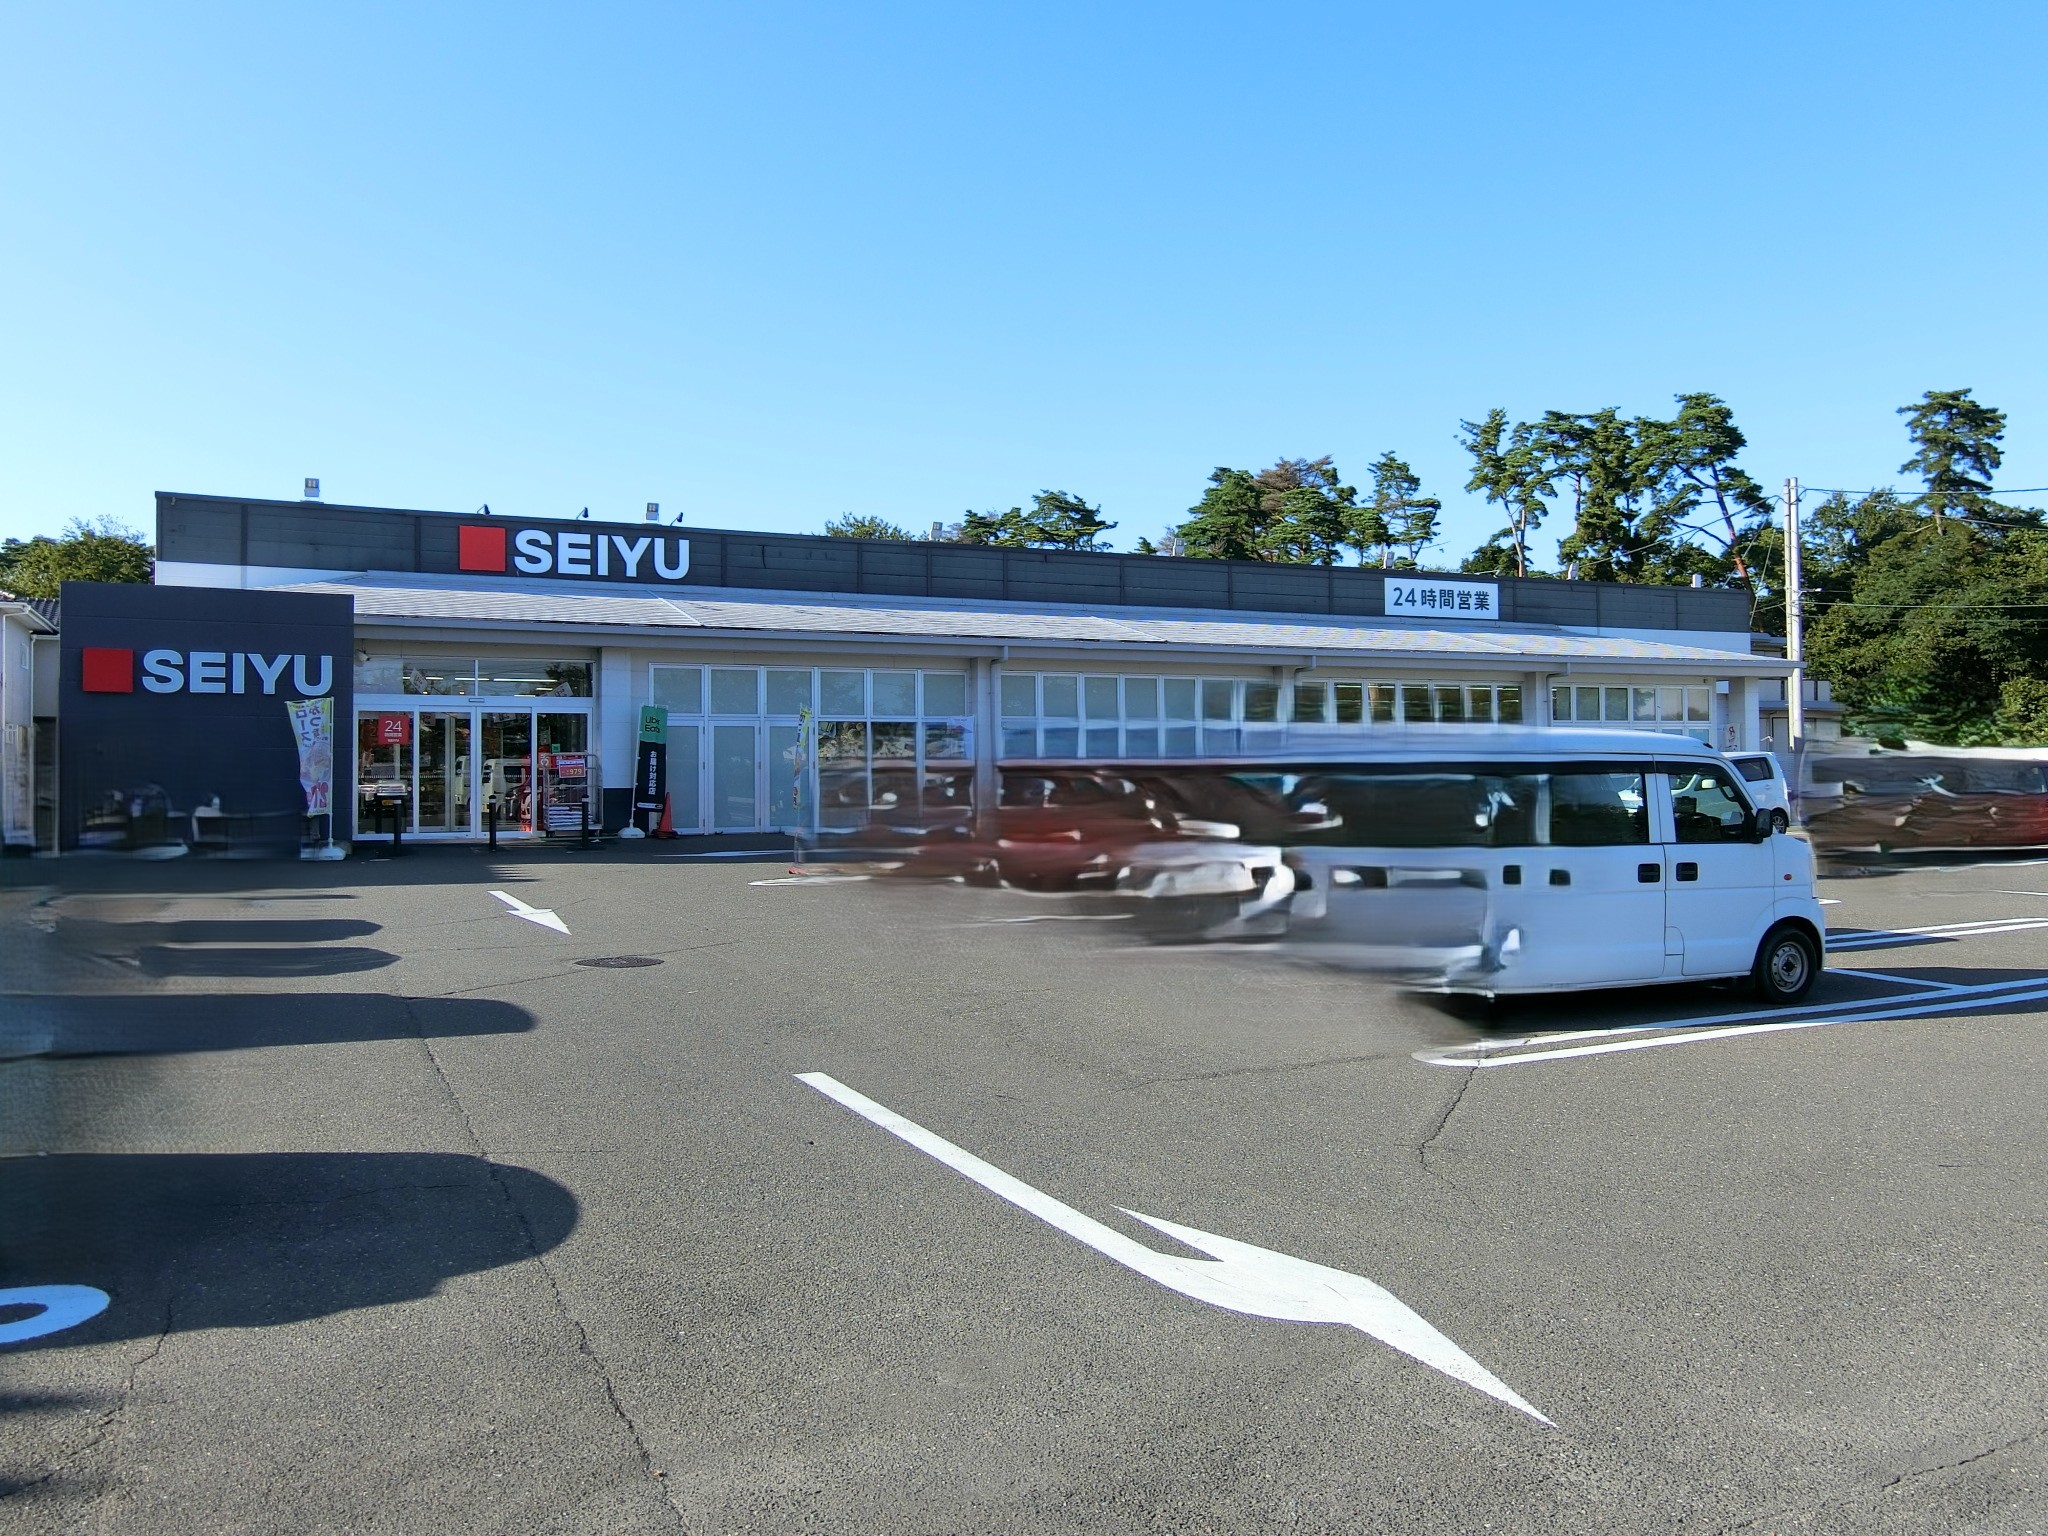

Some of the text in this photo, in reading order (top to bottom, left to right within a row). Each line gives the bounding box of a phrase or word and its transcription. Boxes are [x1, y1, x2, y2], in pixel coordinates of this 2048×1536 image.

[514, 529, 690, 580] SEIYU
[1393, 587, 1489, 611] 24時間営業
[142, 649, 333, 697] SEIYU
[385, 720, 402, 732] 24
